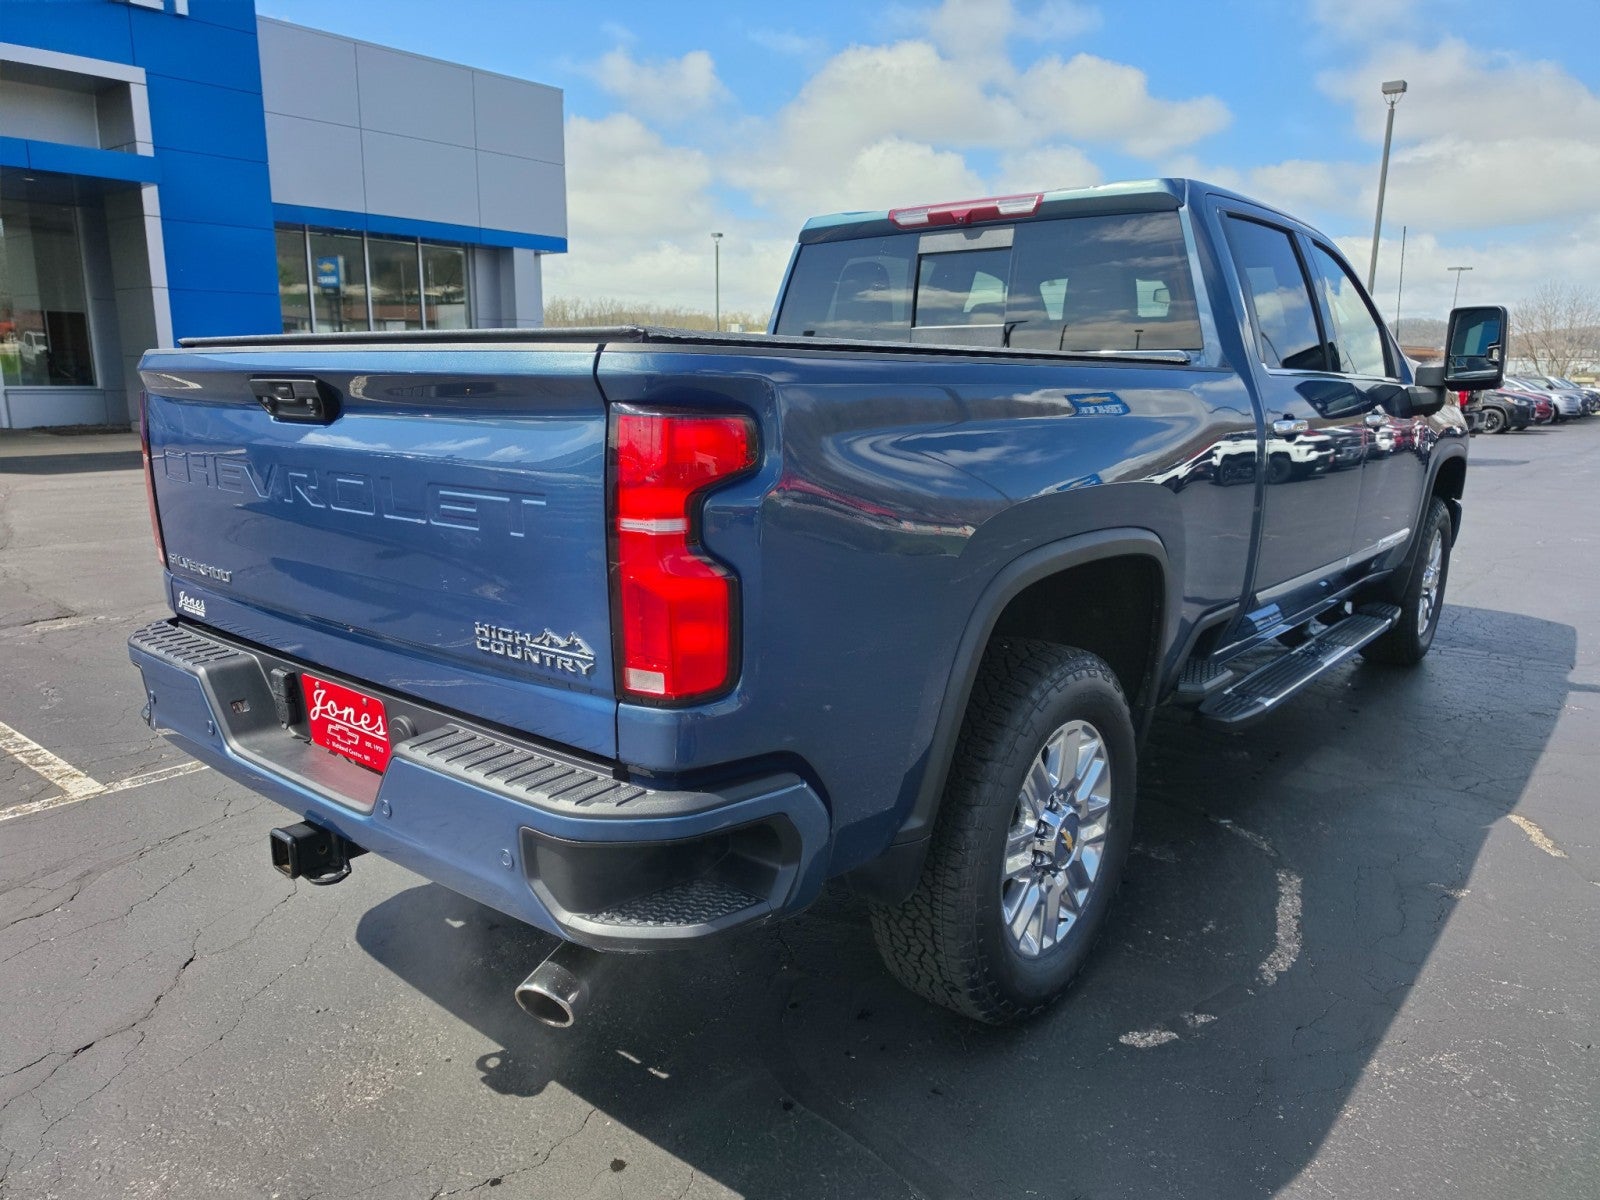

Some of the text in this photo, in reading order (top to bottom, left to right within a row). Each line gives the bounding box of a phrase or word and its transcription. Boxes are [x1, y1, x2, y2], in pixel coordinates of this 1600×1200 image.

[163, 447, 548, 539] CHEVROLET
[178, 590, 206, 610] Jones
[474, 621, 532, 647] HIGH
[475, 636, 595, 675] COUNTRY
[310, 689, 387, 736] Jones
